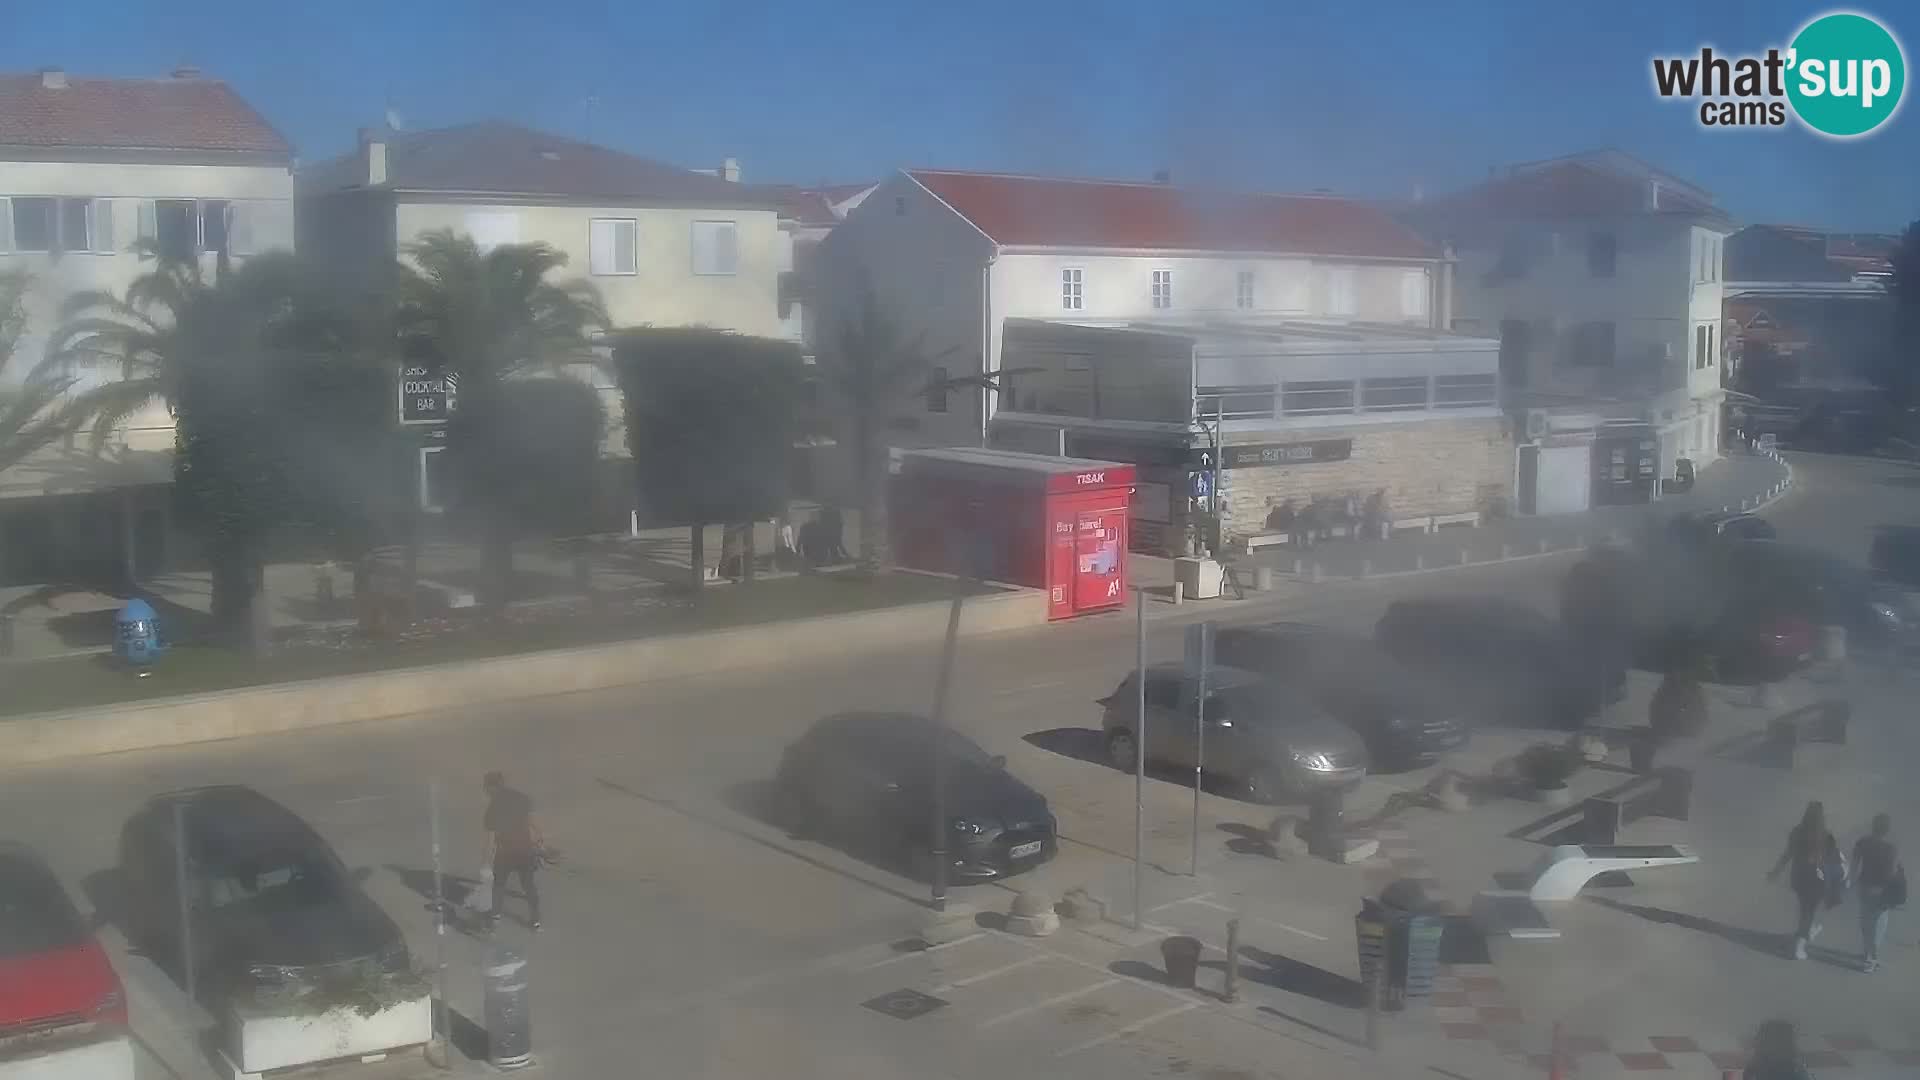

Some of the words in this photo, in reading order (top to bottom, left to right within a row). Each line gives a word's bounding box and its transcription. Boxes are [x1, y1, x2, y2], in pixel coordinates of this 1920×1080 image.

[417, 398, 435, 410] BAR
[1076, 472, 1104, 484] TISAK
[1107, 578, 1119, 597] A1
